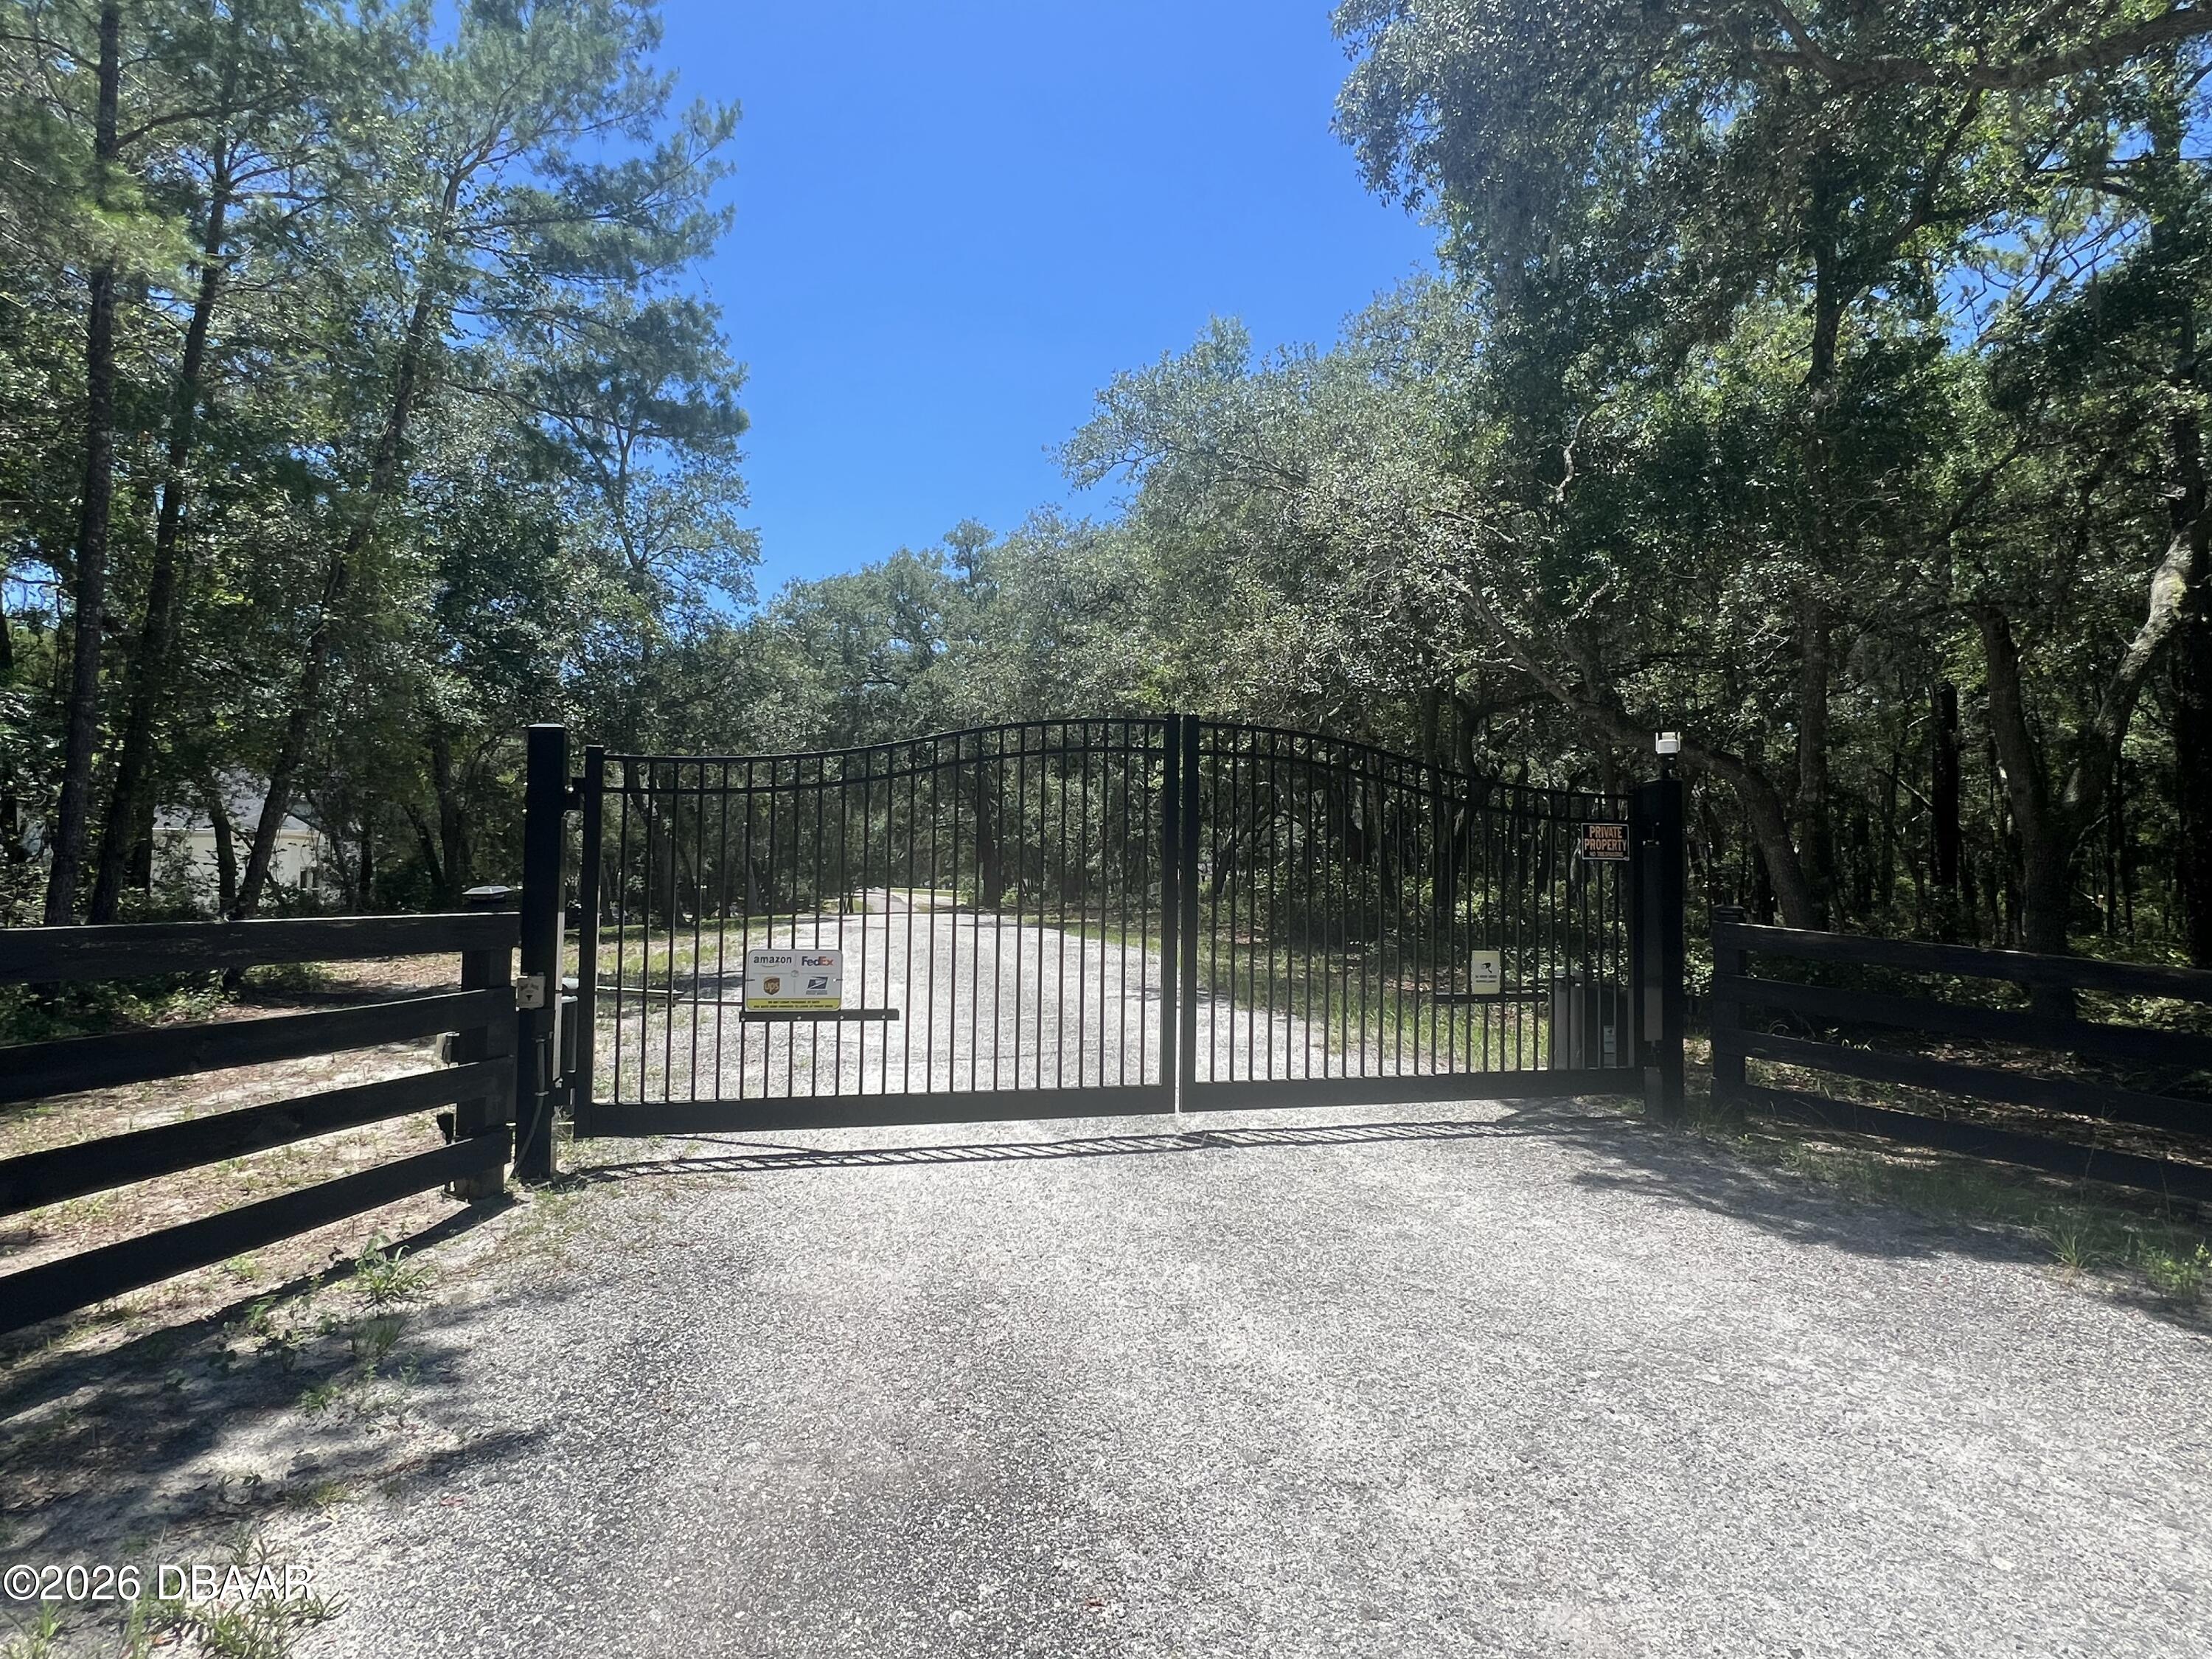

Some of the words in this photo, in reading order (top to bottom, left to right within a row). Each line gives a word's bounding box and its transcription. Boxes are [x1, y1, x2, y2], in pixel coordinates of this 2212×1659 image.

[1589, 826, 1623, 838] PRIVATE
[1585, 838, 1627, 851] PROPERTY
[754, 956, 792, 964] amazon
[801, 956, 834, 967] FedEx
[765, 981, 779, 992] ups
